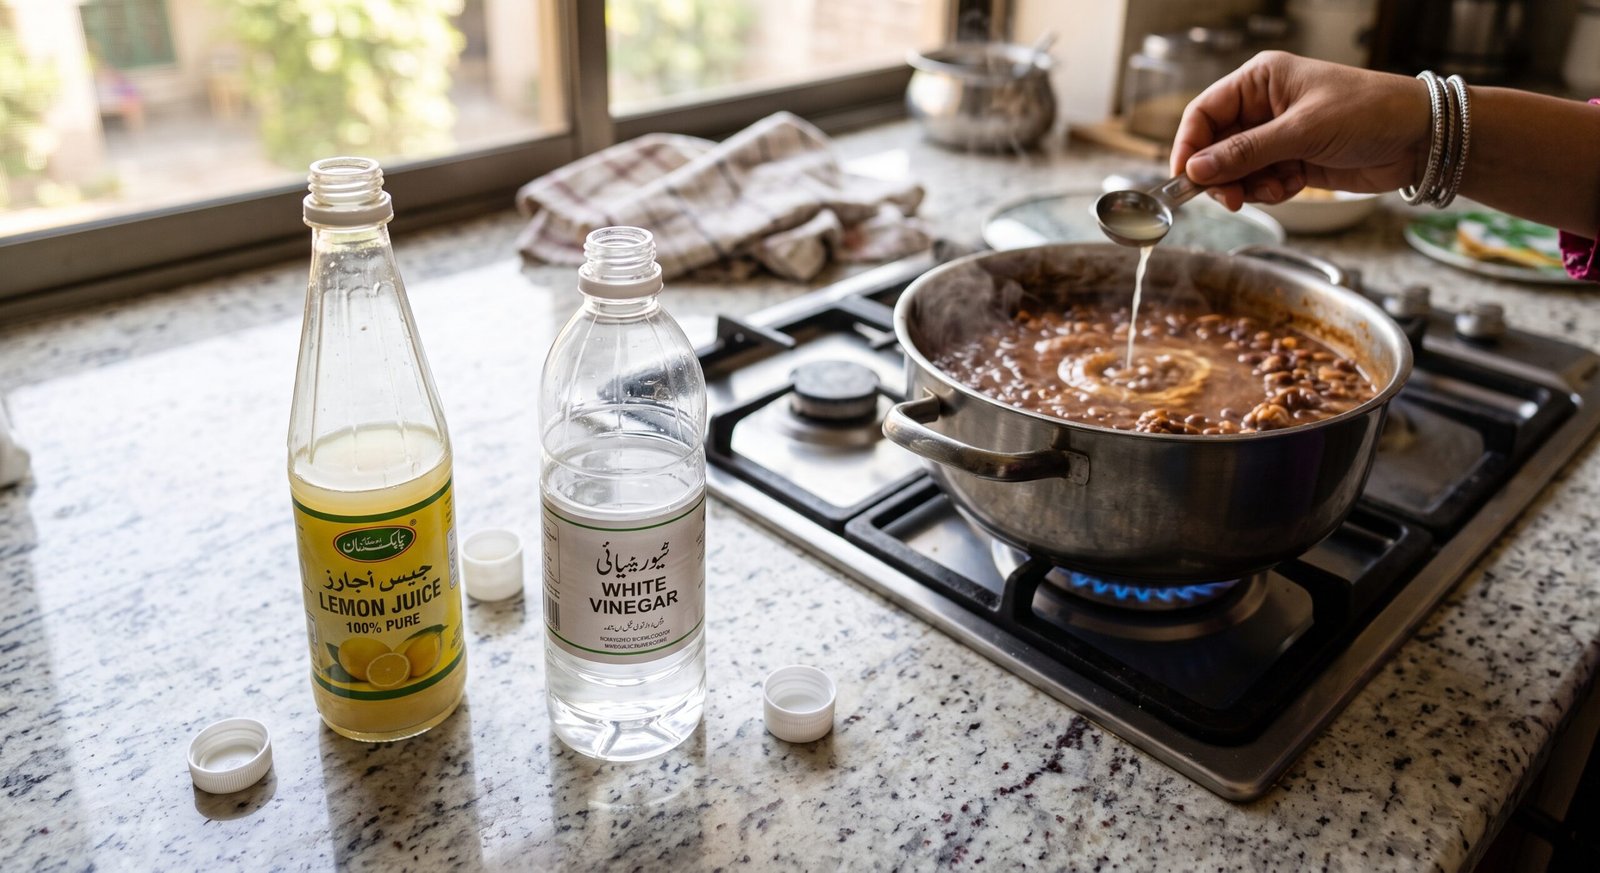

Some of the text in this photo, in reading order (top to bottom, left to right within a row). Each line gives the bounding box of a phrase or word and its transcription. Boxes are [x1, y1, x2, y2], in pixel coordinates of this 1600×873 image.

[319, 578, 442, 617] LEMON JUICE
[602, 576, 667, 597] WHITE
[589, 590, 679, 615] VINEGAR
[346, 612, 421, 634] 100% PURE
